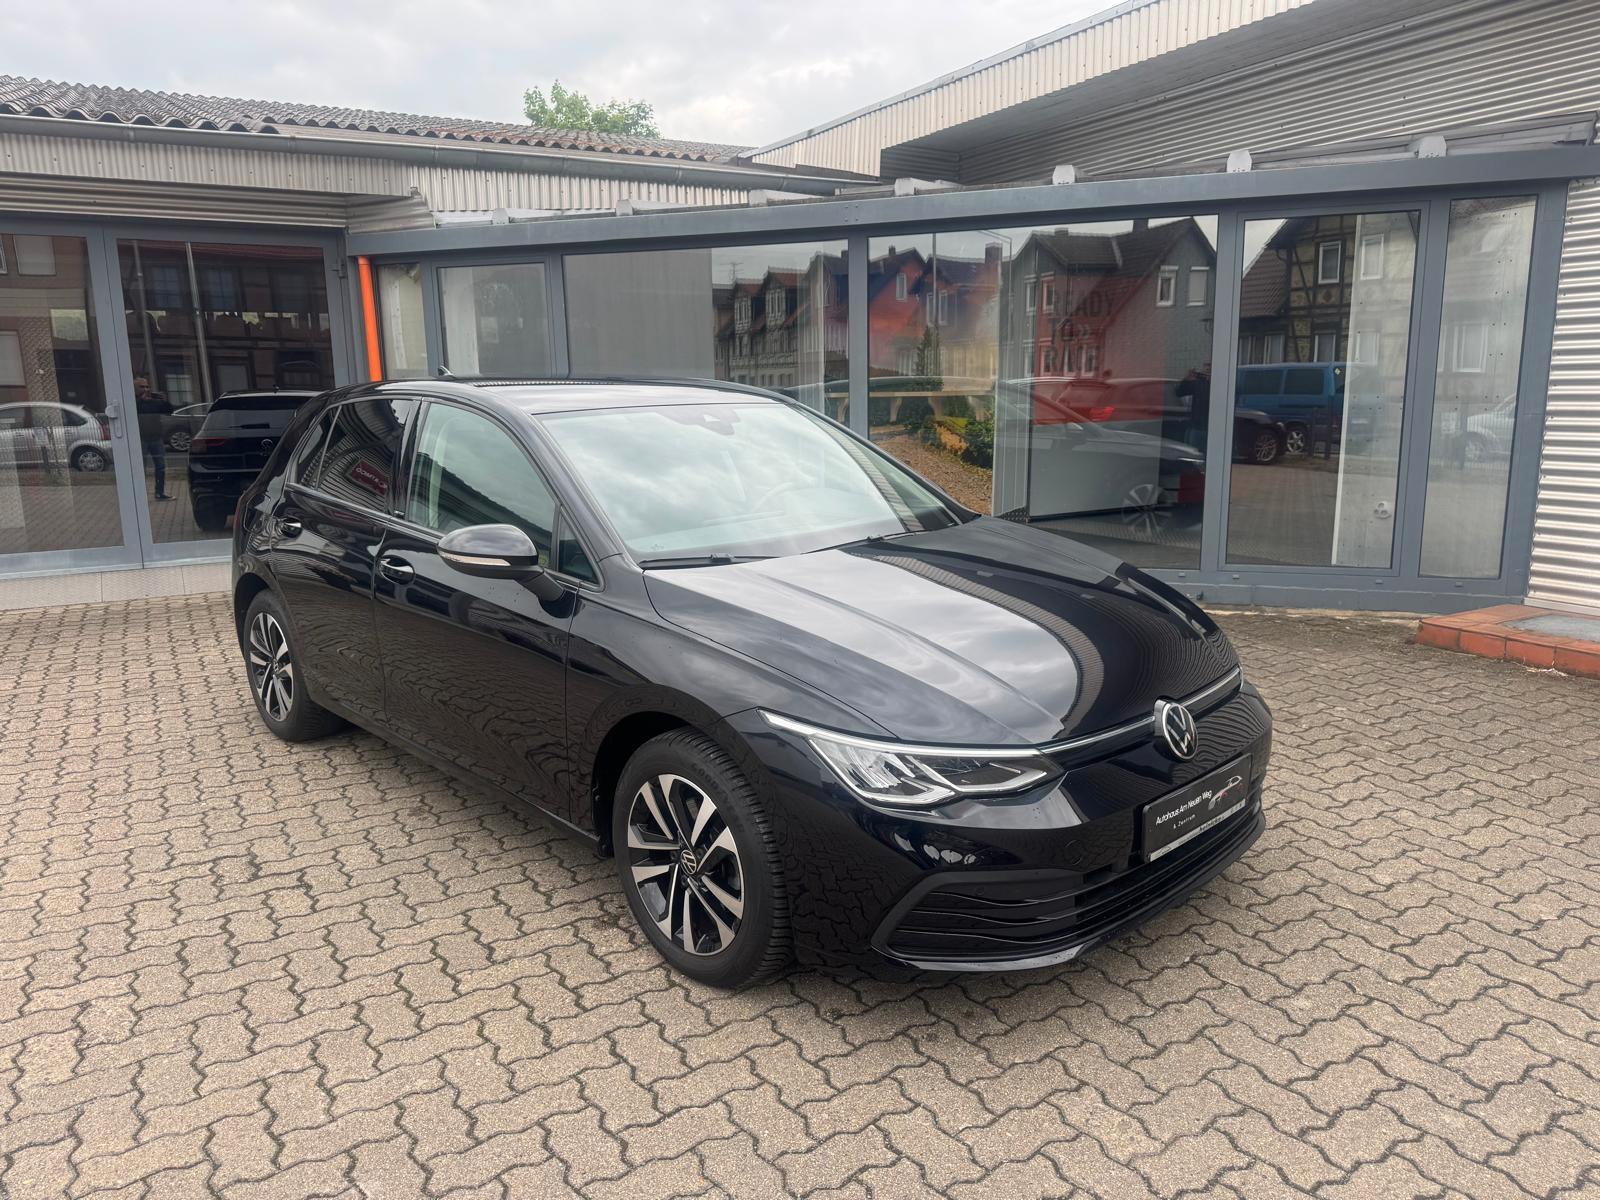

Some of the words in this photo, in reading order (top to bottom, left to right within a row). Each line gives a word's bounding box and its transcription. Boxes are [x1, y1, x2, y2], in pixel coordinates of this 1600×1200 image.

[1156, 809, 1179, 826] Autohaus
[1179, 805, 1188, 813] Am
[1187, 796, 1202, 809] Neuen
[1201, 790, 1212, 800] Weg
